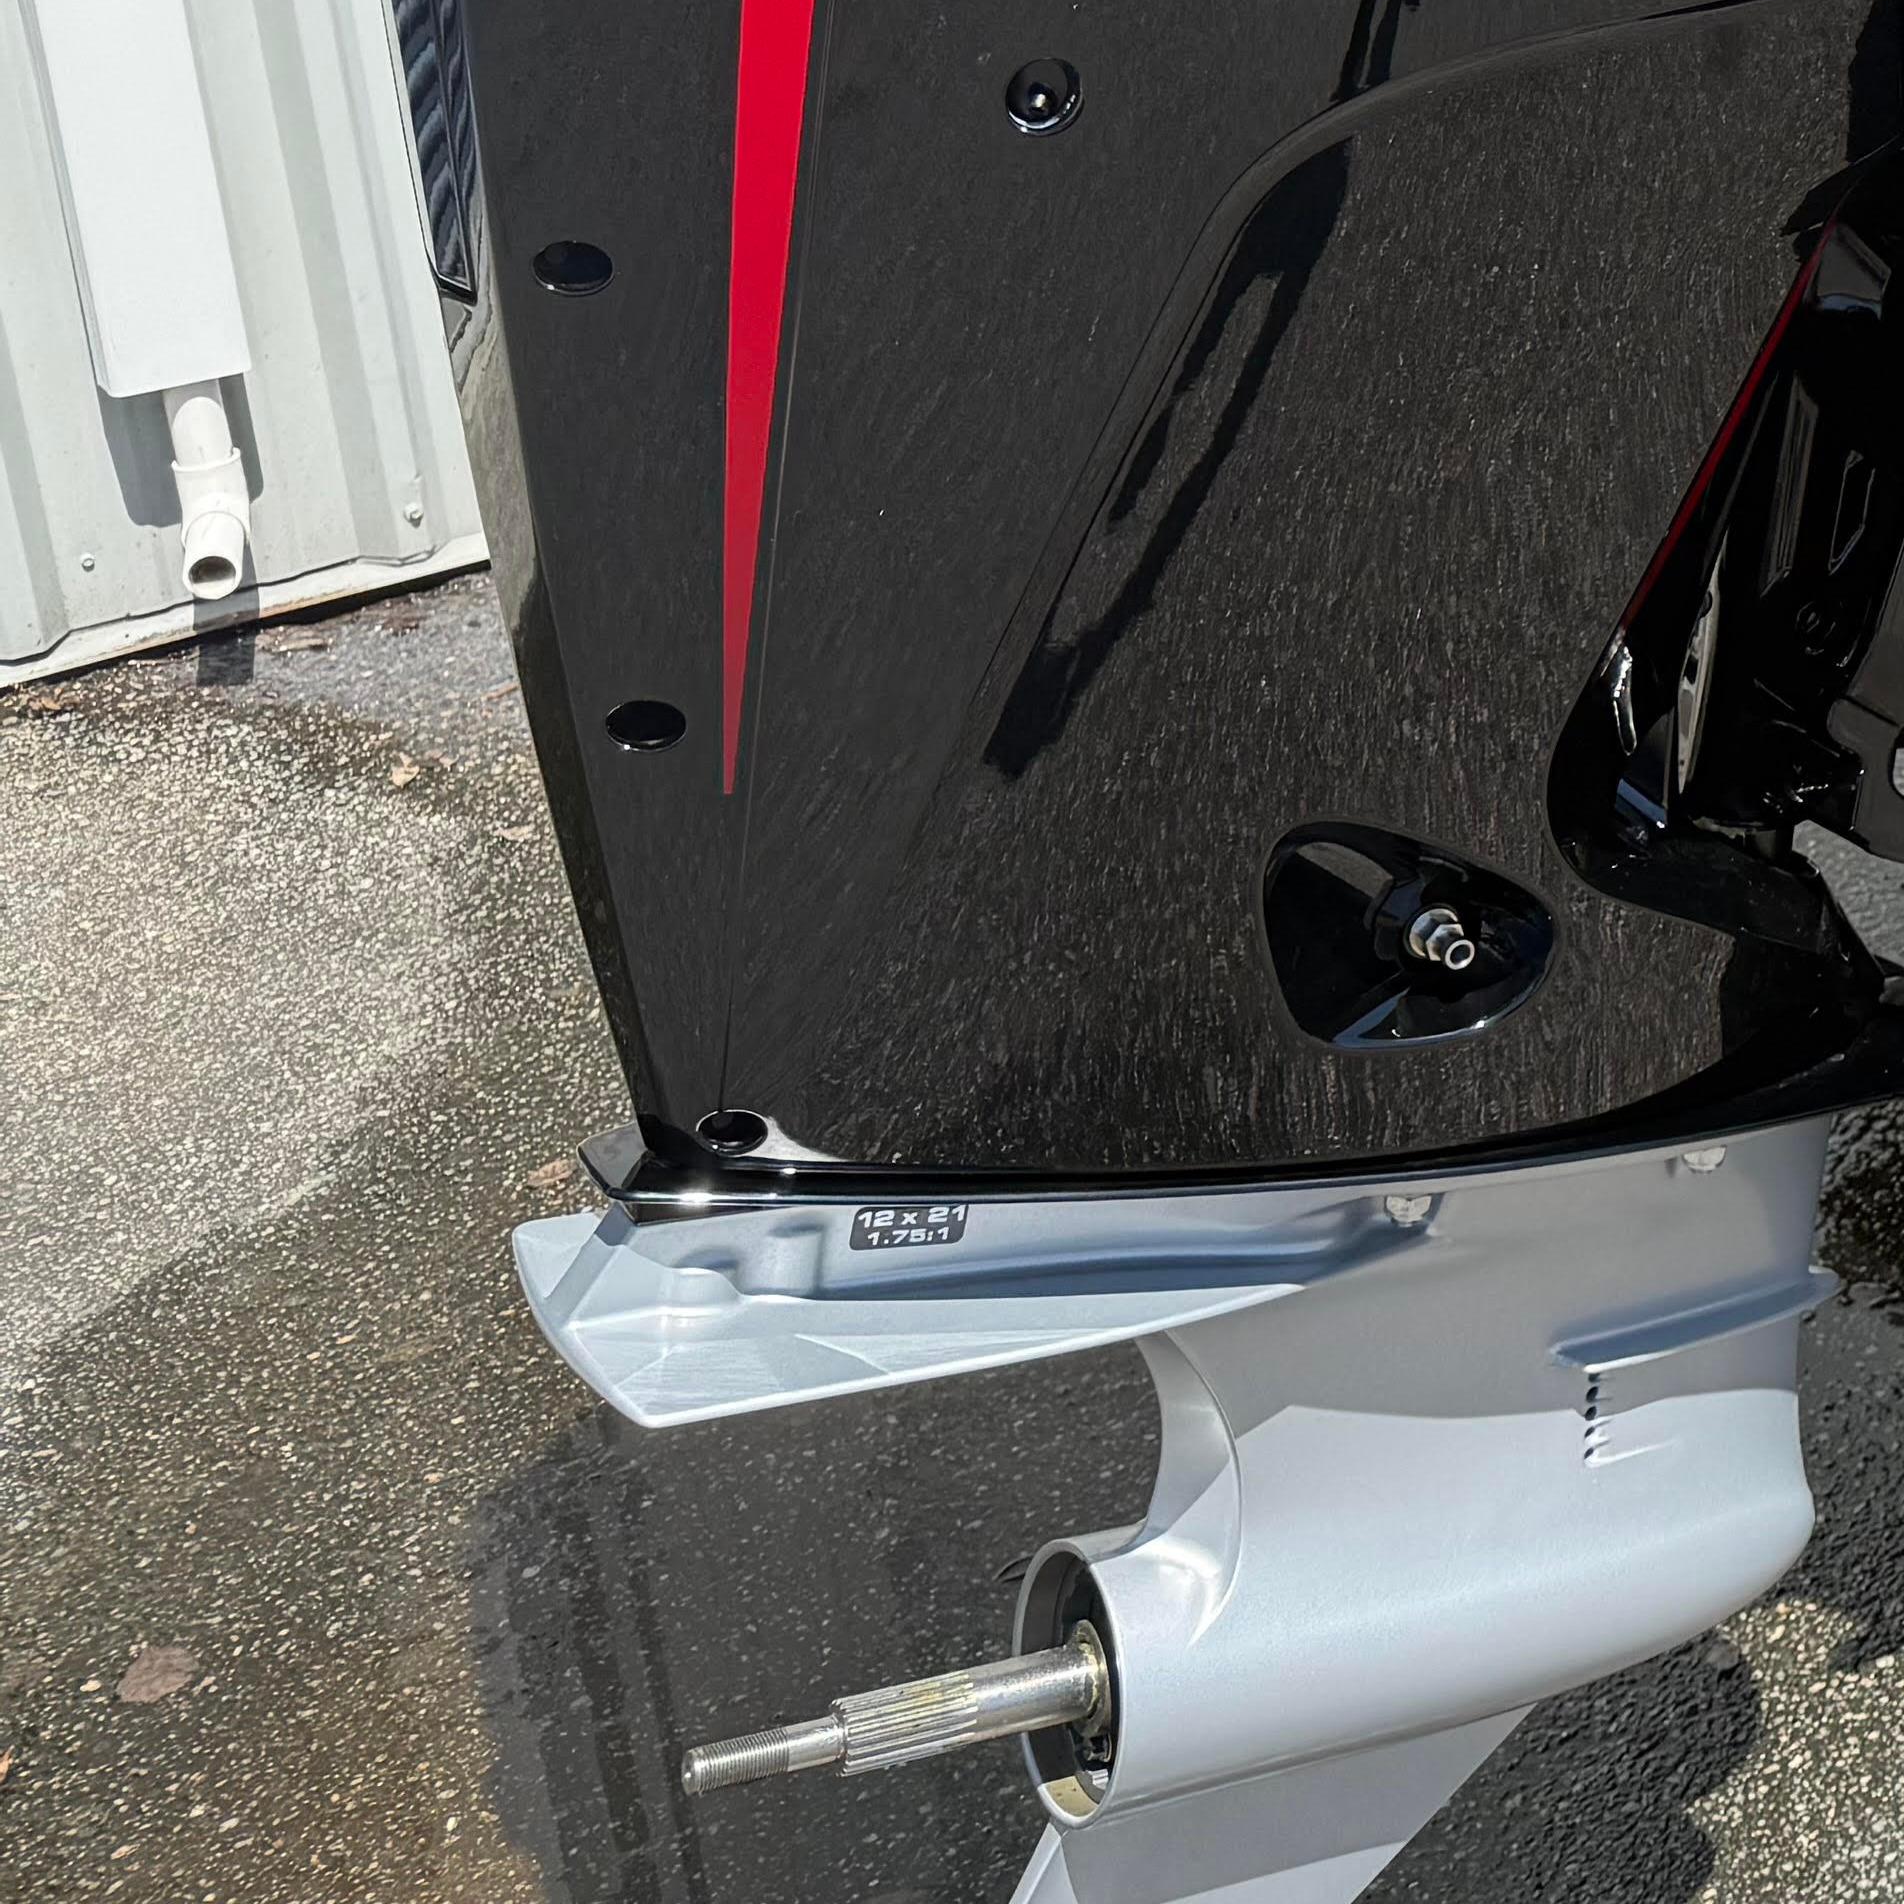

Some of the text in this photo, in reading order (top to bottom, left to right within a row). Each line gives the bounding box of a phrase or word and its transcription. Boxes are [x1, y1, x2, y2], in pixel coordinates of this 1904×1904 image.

[858, 1206, 966, 1228] 12 x 21
[867, 1227, 949, 1246] 1.75:1
